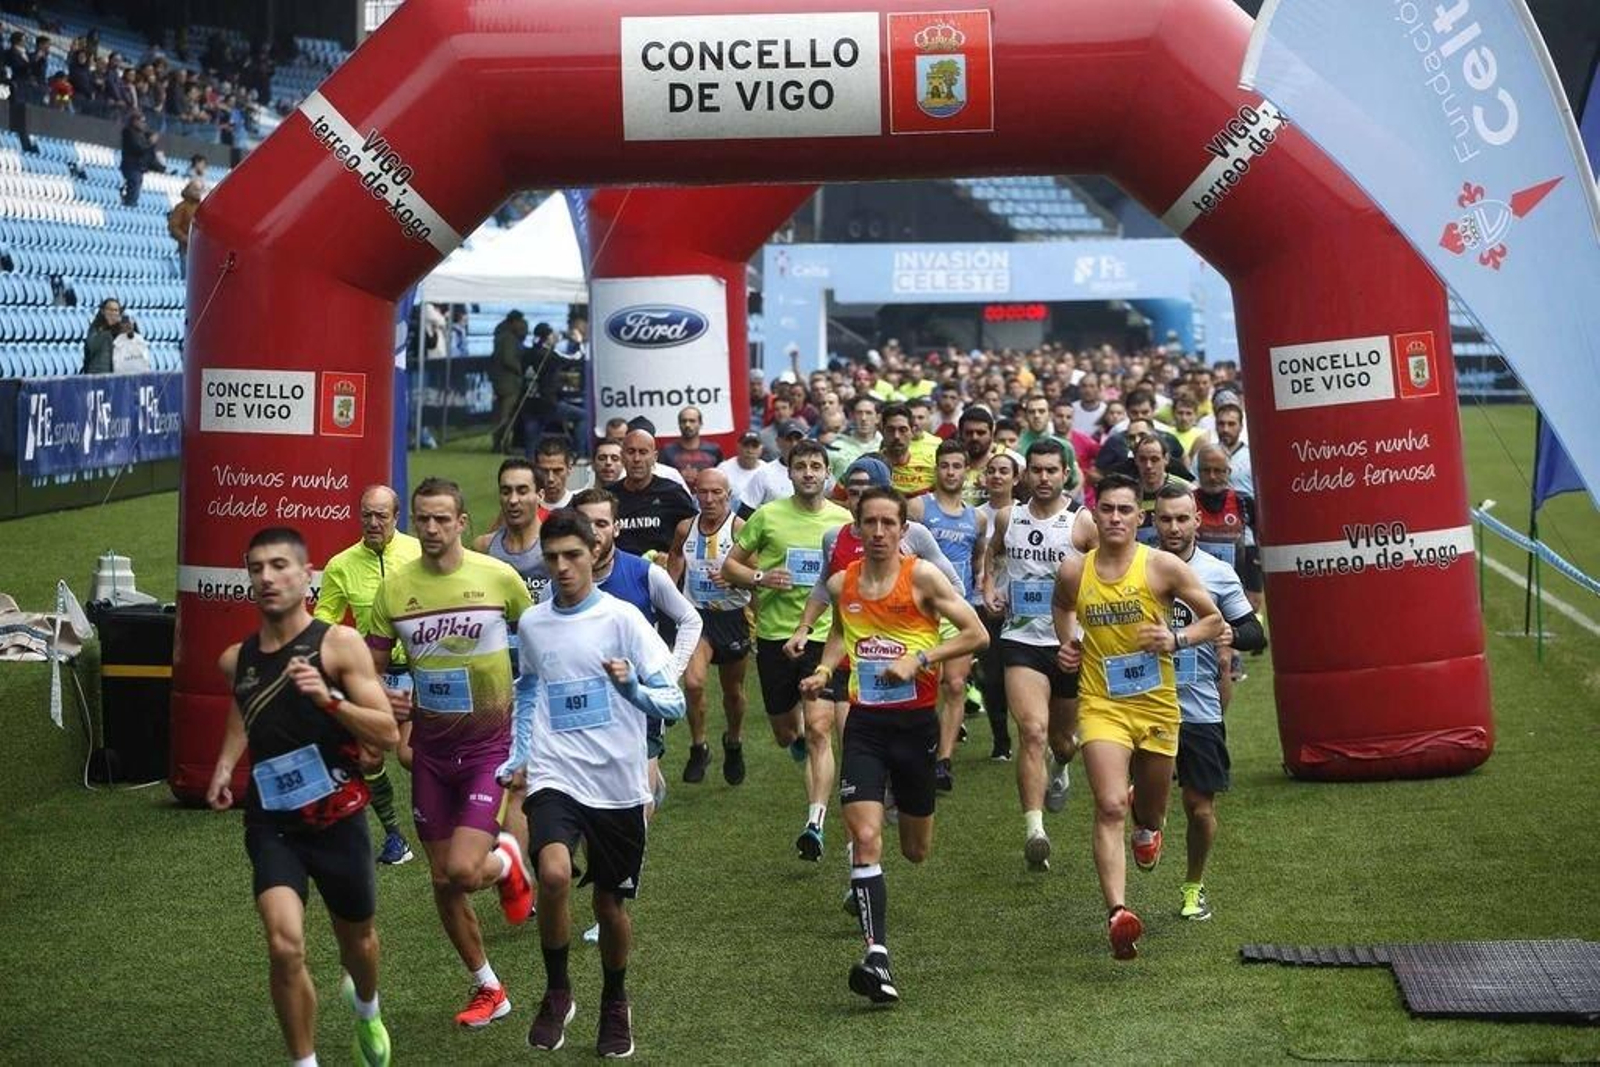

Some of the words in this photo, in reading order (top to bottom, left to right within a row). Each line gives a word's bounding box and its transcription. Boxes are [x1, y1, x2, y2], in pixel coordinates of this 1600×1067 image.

[641, 38, 859, 71] CONCELLO
[668, 82, 720, 112] DE
[735, 79, 834, 111] VIGO
[1205, 104, 1269, 159] VIGO,
[361, 129, 413, 196] VIGO,
[1192, 157, 1250, 214] terreo
[1248, 127, 1275, 156] de
[310, 116, 361, 171] terreo
[361, 171, 388, 200] de
[387, 199, 431, 241] xogo
[894, 248, 1009, 269] INVASIÓN
[896, 272, 1008, 290] CELESTE
[620, 311, 688, 340] Ford
[1279, 350, 1380, 375] CONCELLO
[207, 382, 304, 400] CONCELLO
[1291, 377, 1314, 394] DE
[1322, 371, 1371, 390] VIGO
[601, 385, 721, 408] Galmotor
[215, 403, 236, 418] DE
[243, 403, 291, 420] VIGO
[1292, 440, 1368, 463] Vivimos
[1375, 428, 1431, 454] nunha
[212, 465, 284, 488] Vivimos
[291, 468, 349, 490] nunha
[1292, 466, 1355, 493] cidade
[1363, 463, 1436, 487] fermosa
[207, 494, 267, 518] cidade
[276, 496, 351, 520] fermosa
[615, 516, 661, 529] MANDO
[1343, 522, 1415, 549] VIGO,
[1296, 554, 1365, 578] terreo
[1375, 548, 1404, 570] de
[1412, 544, 1459, 570] xogo
[412, 616, 483, 645] delikia
[429, 683, 450, 696] 452
[565, 695, 588, 711] 497
[275, 769, 303, 793] 333
